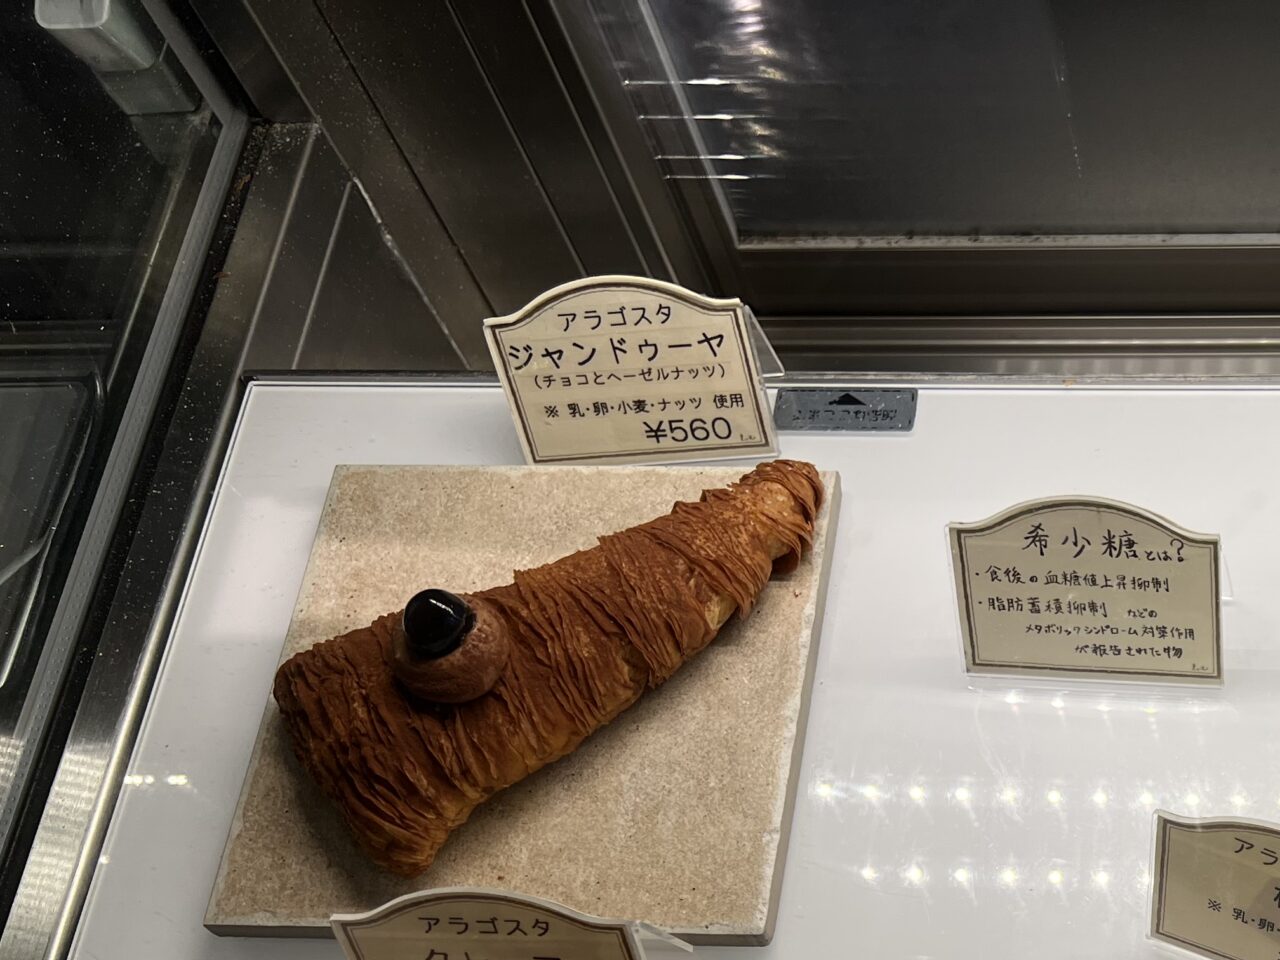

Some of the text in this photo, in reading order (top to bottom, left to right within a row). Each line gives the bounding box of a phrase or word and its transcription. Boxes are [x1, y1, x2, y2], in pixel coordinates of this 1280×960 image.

[556, 303, 674, 332] アラゴスタ
[508, 331, 725, 371] ジャンドゥーヤ
[712, 393, 745, 410] 使用
[644, 417, 733, 444] ¥560
[417, 916, 551, 938] アラゴスタ
